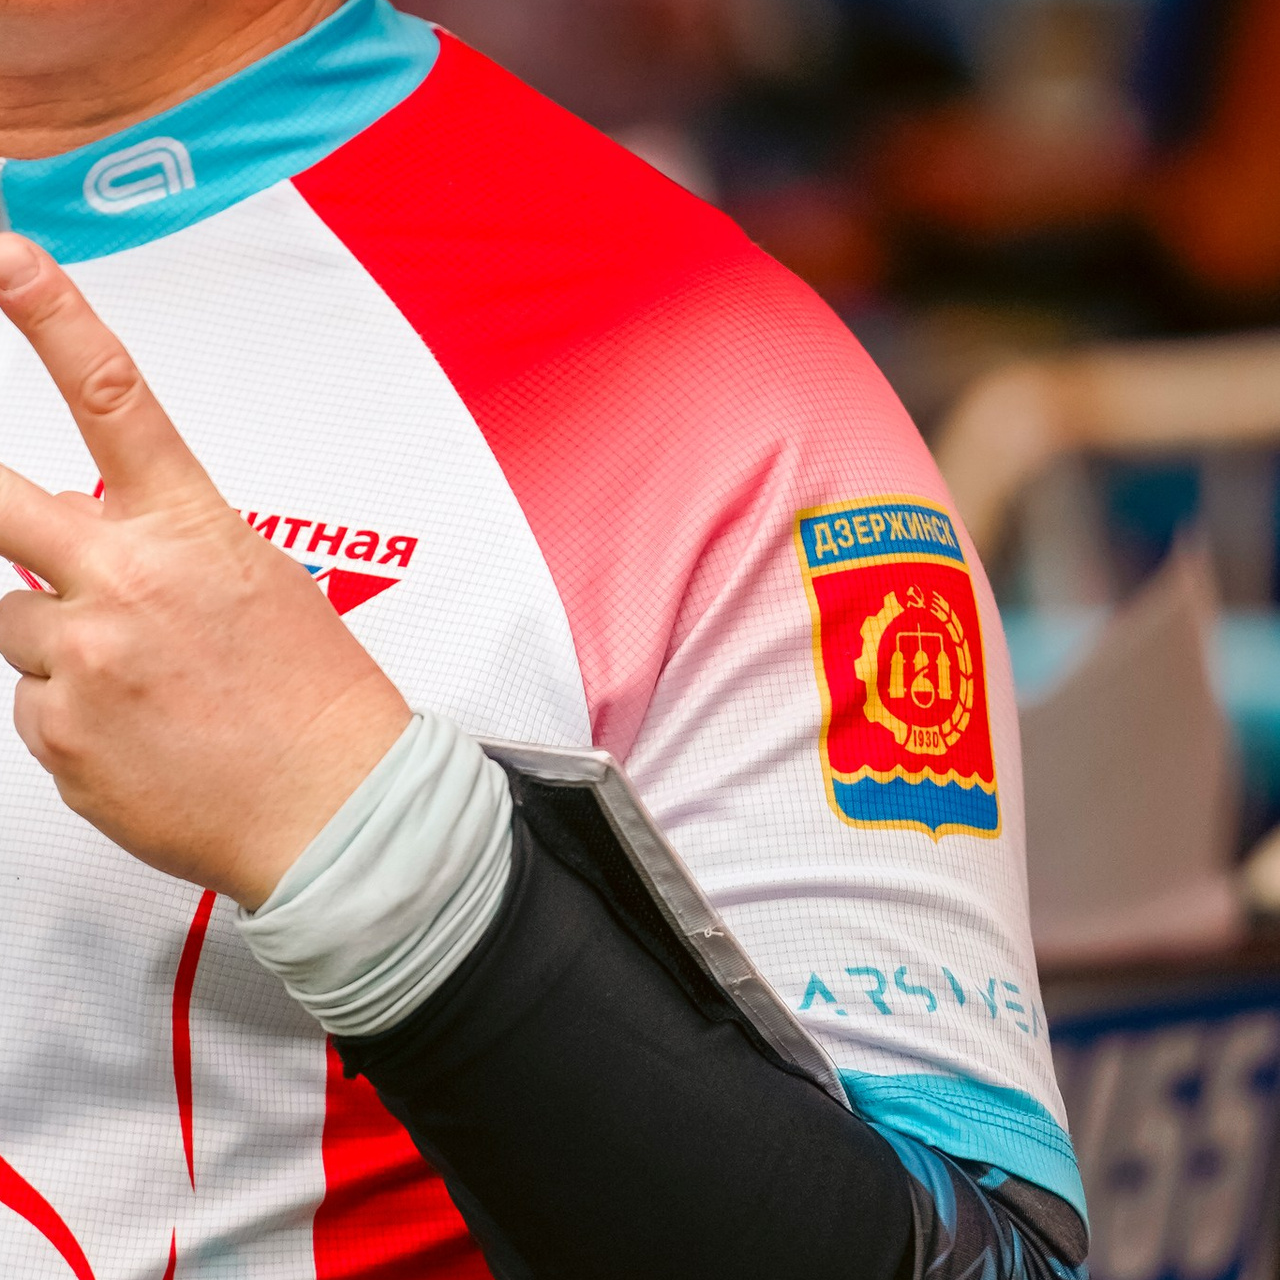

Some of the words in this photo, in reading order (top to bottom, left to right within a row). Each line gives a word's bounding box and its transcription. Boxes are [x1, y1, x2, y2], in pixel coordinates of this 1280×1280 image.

[233, 509, 419, 568] итная
[814, 511, 957, 559] ДЗЕРЖИНСК
[913, 729, 939, 749] 1930
